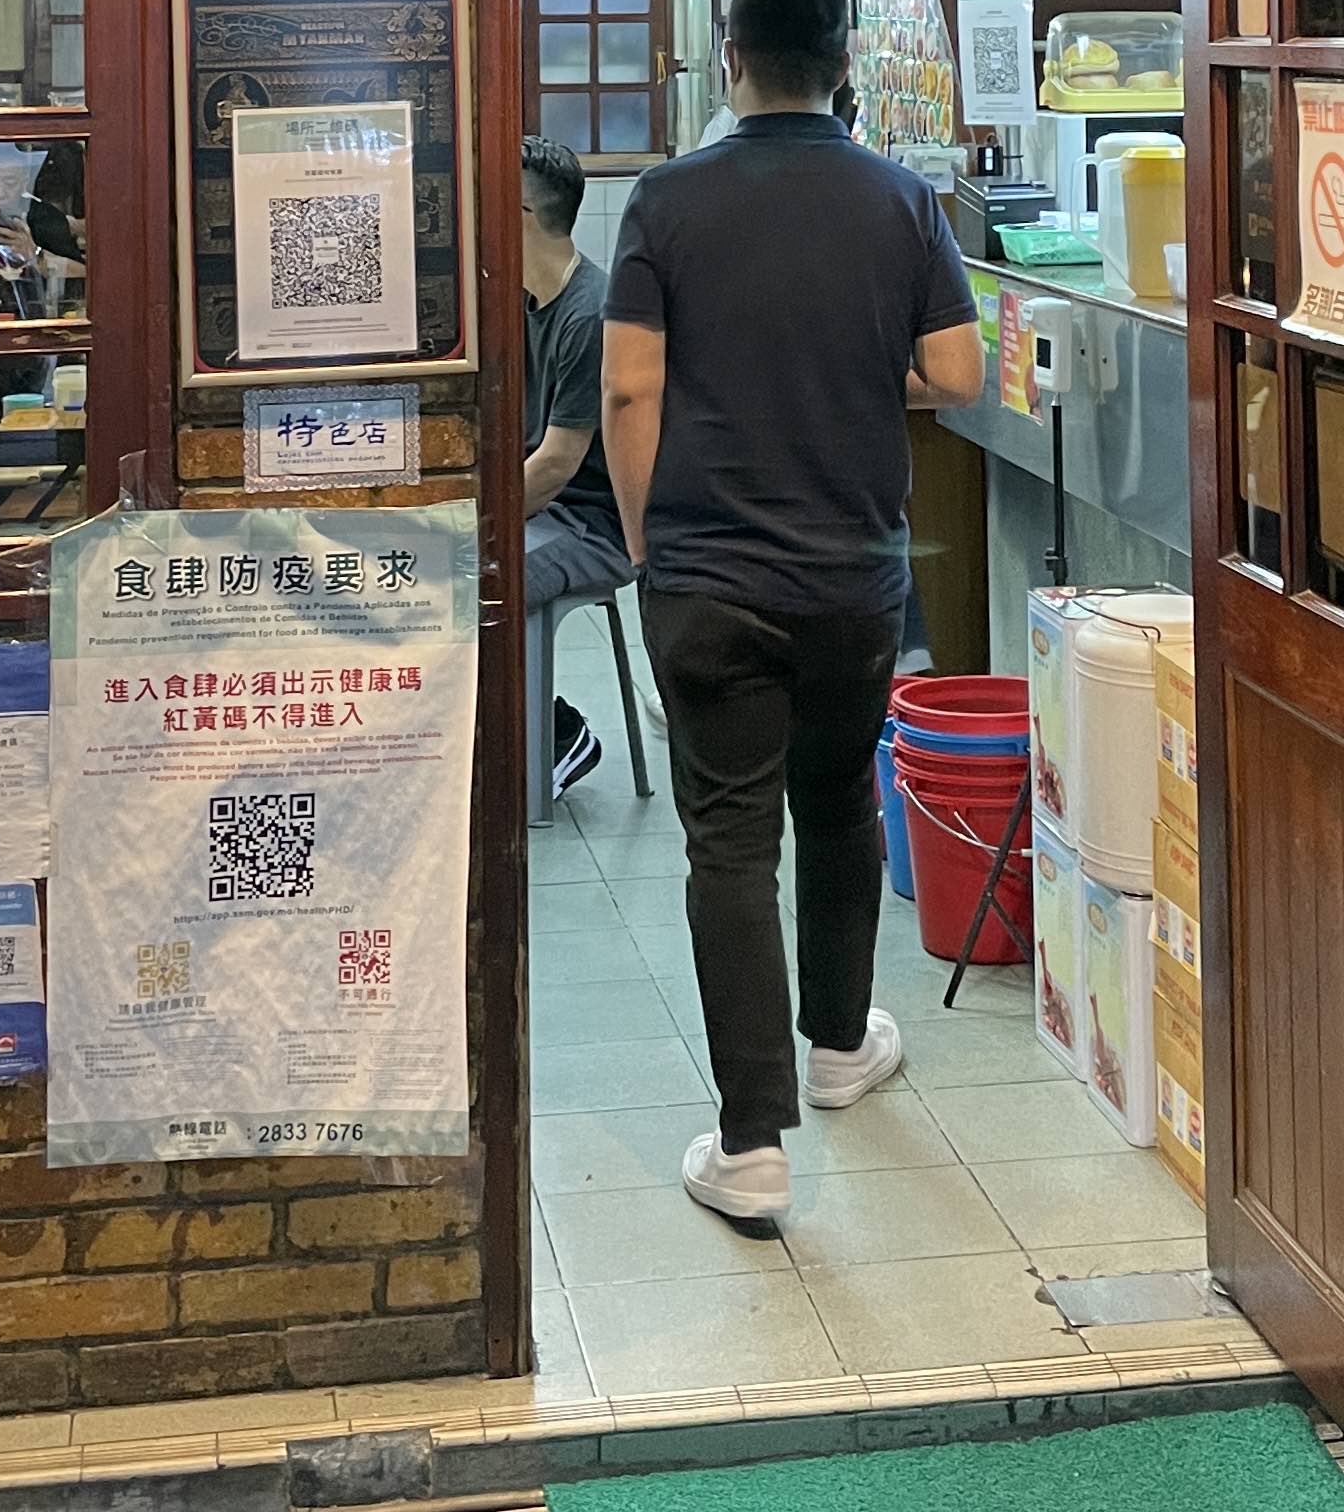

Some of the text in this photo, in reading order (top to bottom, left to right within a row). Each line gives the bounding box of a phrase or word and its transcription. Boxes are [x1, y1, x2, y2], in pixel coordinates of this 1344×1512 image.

[277, 412, 387, 448] 特色店
[112, 550, 417, 602] 食肆防疫要求
[275, 626, 298, 637] food
[104, 665, 423, 704] 進入食肆必須出示健康碼
[163, 701, 365, 733] 紅黃碼不得進入
[258, 1123, 307, 1144] 2833
[314, 1123, 364, 1141] 7676
